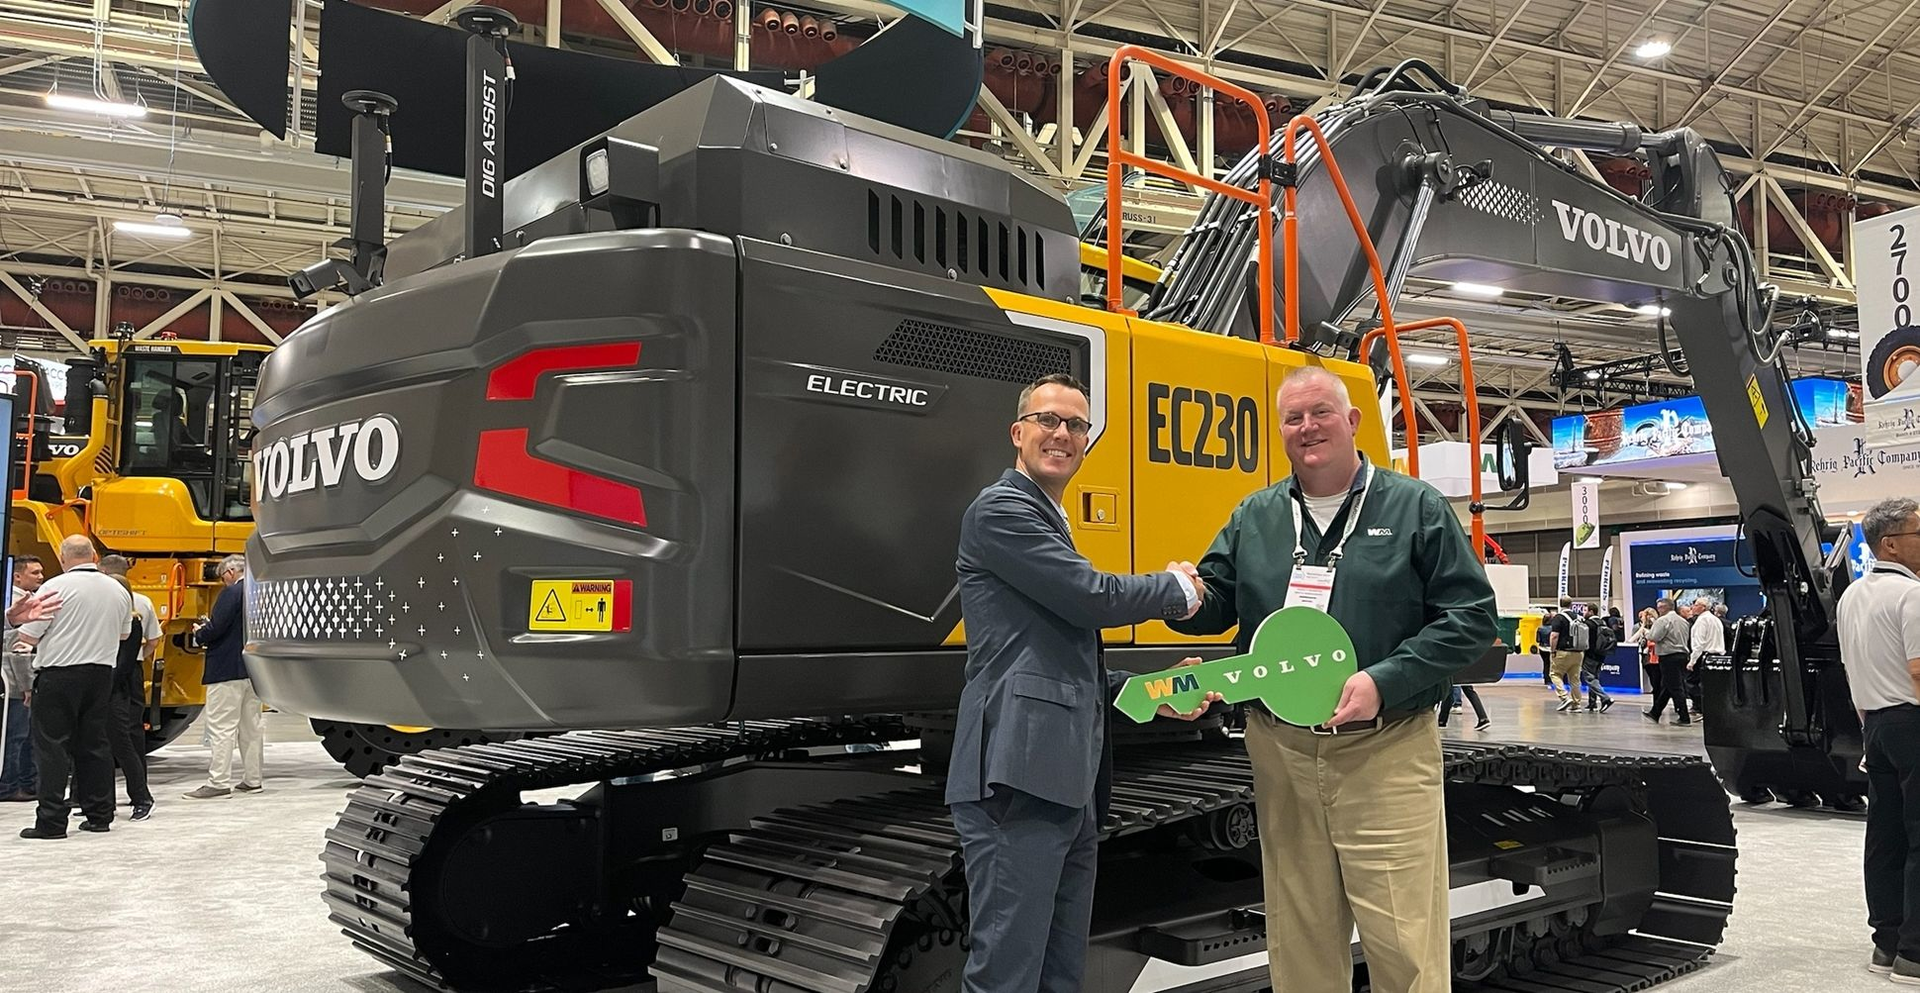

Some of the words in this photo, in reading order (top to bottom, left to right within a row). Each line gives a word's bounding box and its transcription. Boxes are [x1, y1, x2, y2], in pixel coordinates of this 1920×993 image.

[482, 69, 497, 155] ASSIST
[482, 158, 496, 198] DIG
[1122, 212, 1156, 224] RUSS-31
[1551, 199, 1671, 271] VOLVO
[1890, 224, 1912, 328] 2700
[806, 374, 929, 406] ELECTRIC
[1147, 382, 1259, 473] EC230
[253, 417, 400, 502] VOLVO
[1581, 486, 1589, 524] 3000
[580, 584, 612, 593] WARNING
[1144, 672, 1200, 700] WM
[1223, 649, 1347, 684] VOLVO
